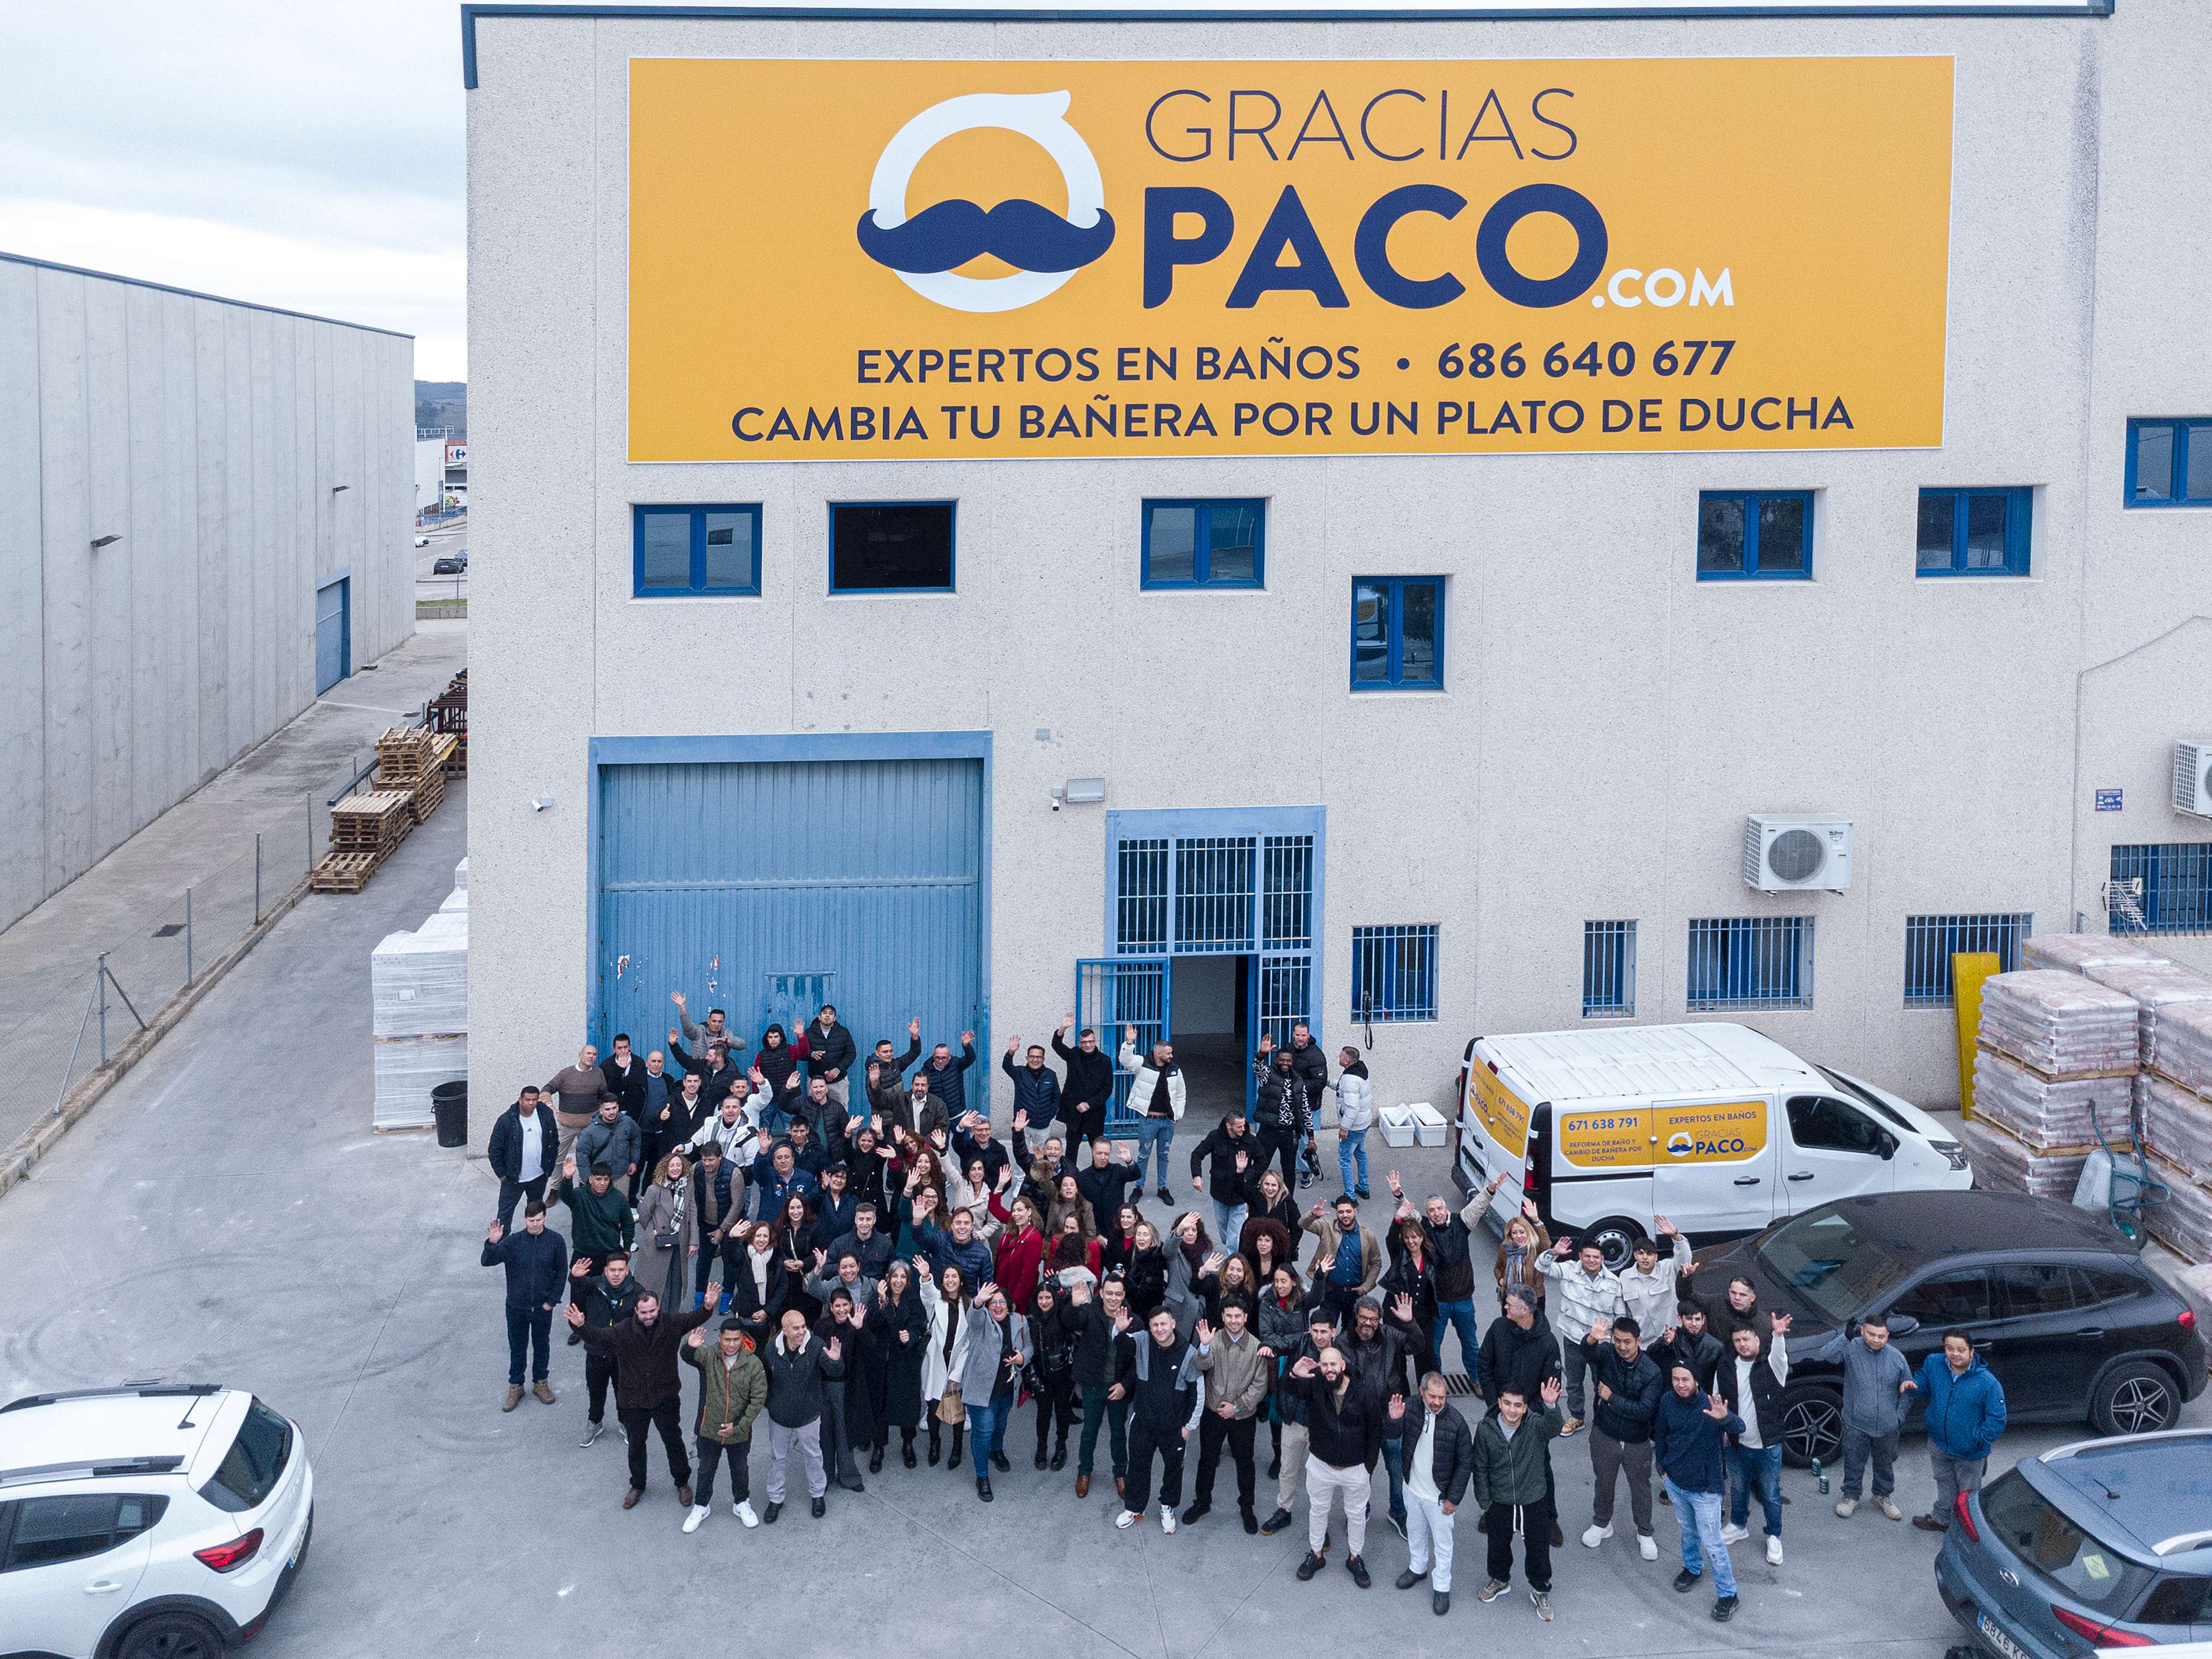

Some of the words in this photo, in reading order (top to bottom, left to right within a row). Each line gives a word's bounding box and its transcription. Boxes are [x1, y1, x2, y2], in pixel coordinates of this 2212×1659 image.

[1145, 88, 1578, 163] GRACIAS
[1143, 184, 1608, 309] PACO
[1592, 267, 1734, 308] .COM
[858, 347, 1099, 384] EXPERTOS
[1117, 347, 1177, 381] EN
[1196, 336, 1360, 380] BAÑOS
[1438, 342, 1526, 379] 686
[1543, 341, 1636, 378] 640
[1652, 340, 1736, 377] 677
[732, 406, 928, 442] CAMBIA
[941, 405, 1000, 440] TU
[1020, 394, 1218, 439] BAÑERA
[1234, 402, 1333, 436] POR
[1350, 401, 1418, 436] UN
[1437, 400, 1584, 435] PLATO
[1602, 399, 1662, 433] DE
[1679, 396, 1854, 432] DUCHA
[1568, 1120, 1588, 1131] 671
[1592, 1118, 1614, 1130] 638
[1619, 1117, 1637, 1128] 791
[1669, 1115, 1712, 1124] EXPERTOS
[1728, 1110, 1757, 1120] BAÑOS
[1695, 1128, 1741, 1140] GRACIAS
[1695, 1139, 1744, 1155] PACO
